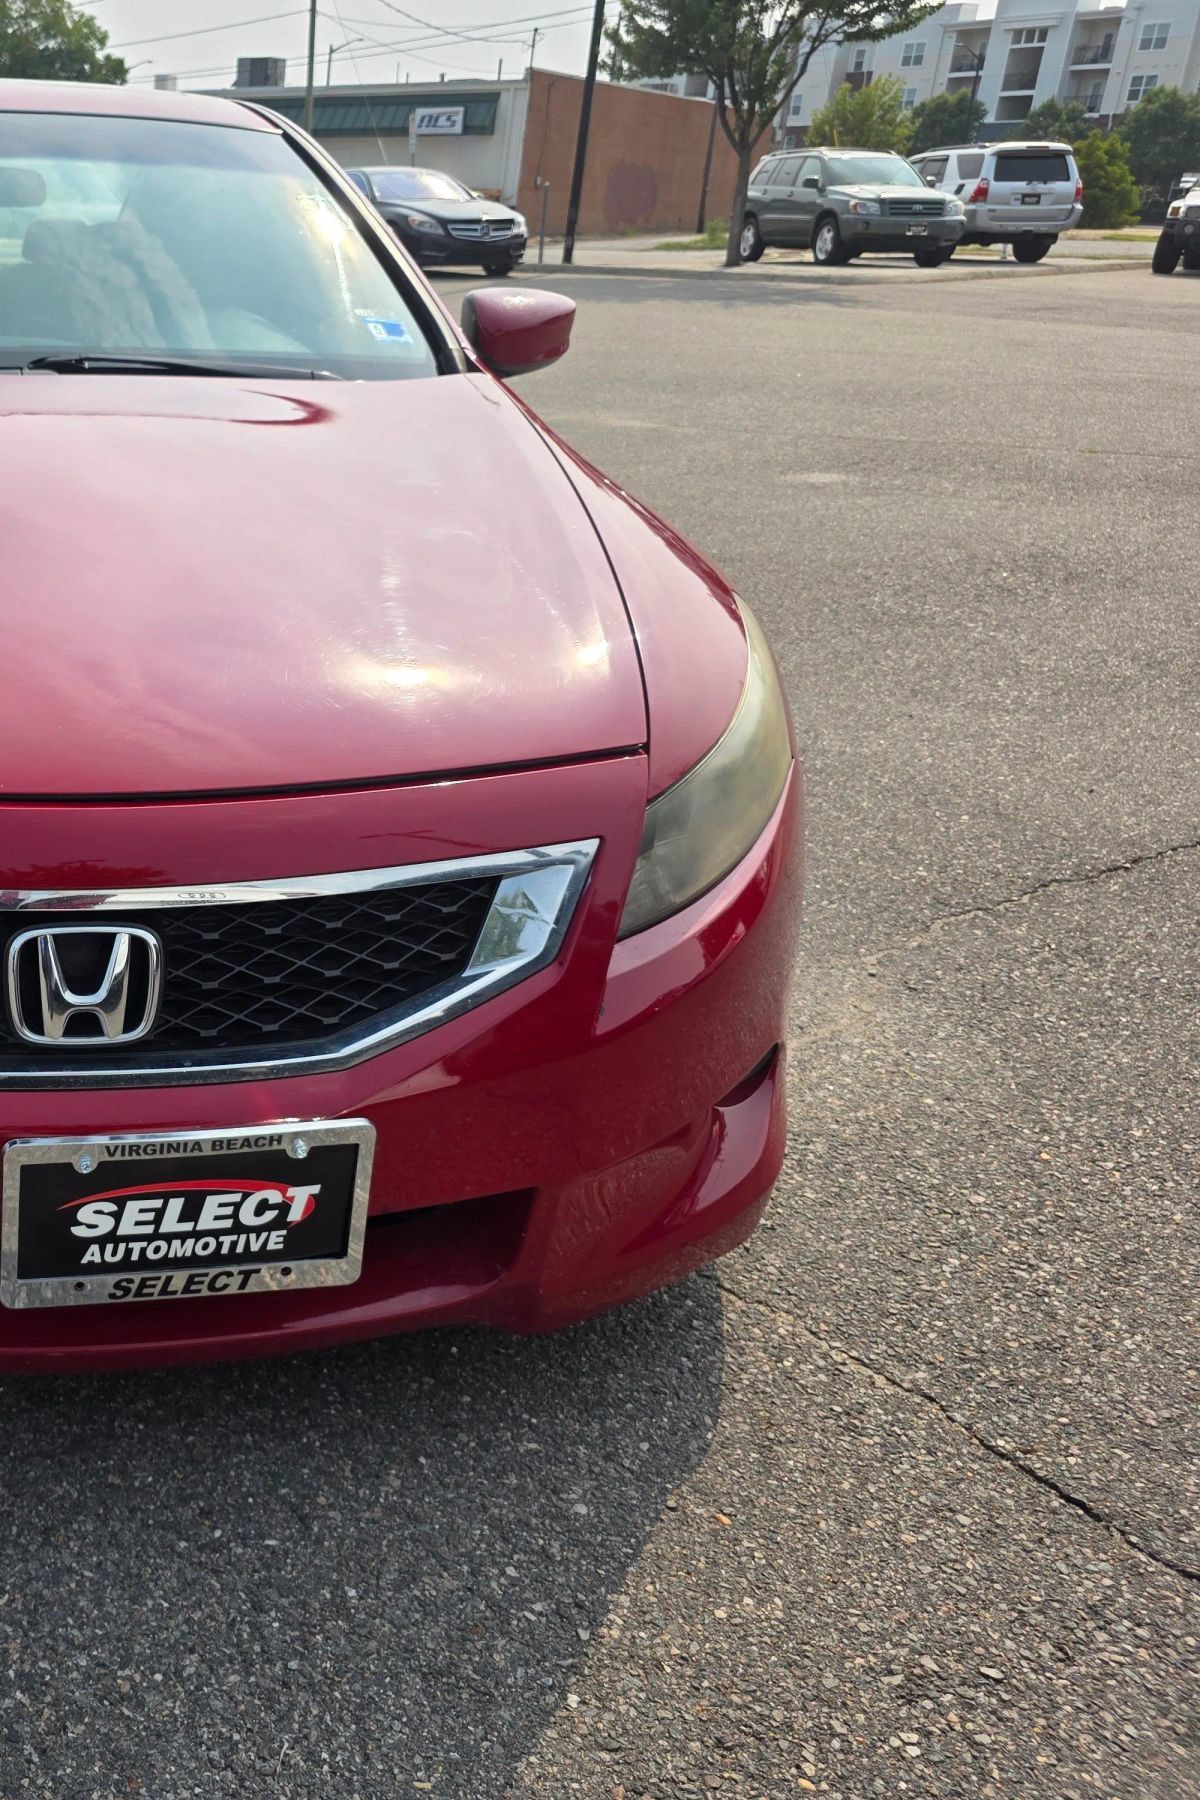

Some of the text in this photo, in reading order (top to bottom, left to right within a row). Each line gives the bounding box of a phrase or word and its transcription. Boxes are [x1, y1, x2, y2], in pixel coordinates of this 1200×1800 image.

[104, 1134, 283, 1159] VIRGINIA BEACH
[70, 1184, 322, 1238] SELECT
[80, 1229, 288, 1264] AUTOMOTIVE
[107, 1268, 262, 1300] SELECT
